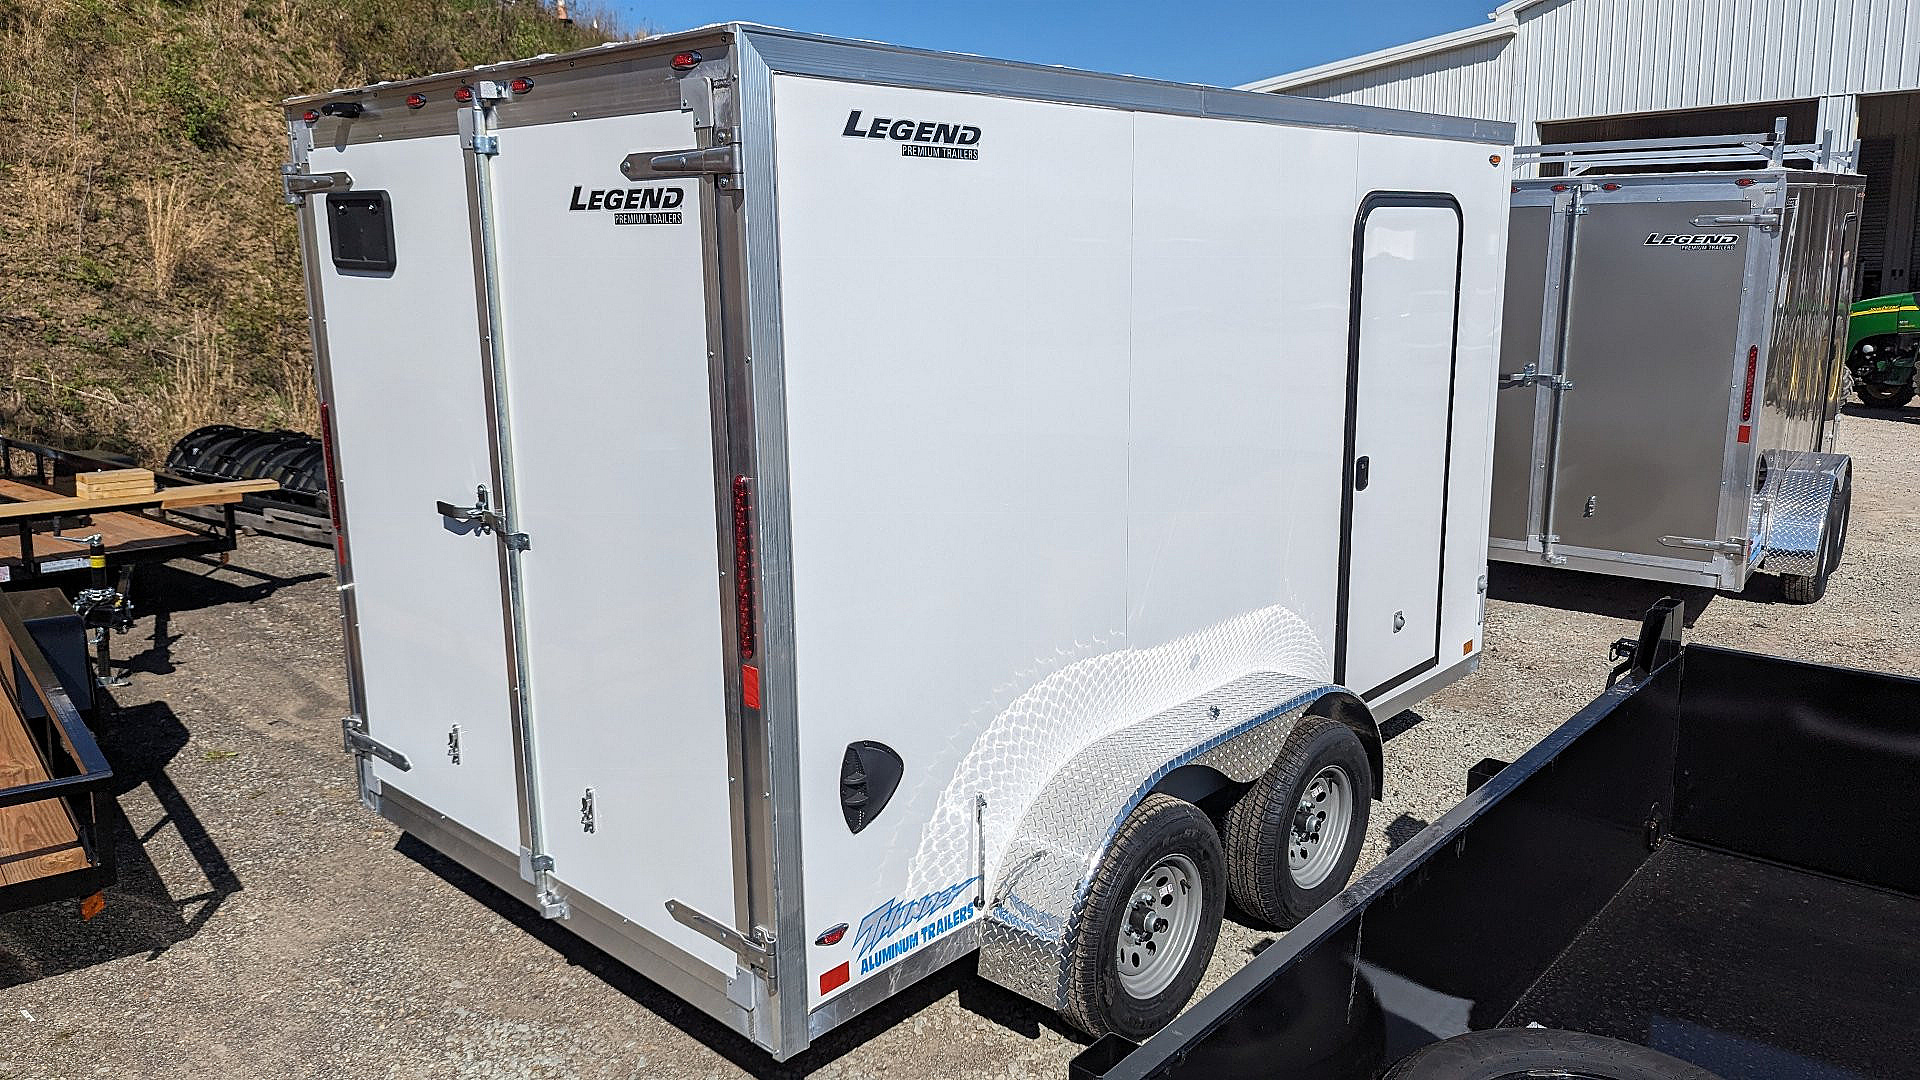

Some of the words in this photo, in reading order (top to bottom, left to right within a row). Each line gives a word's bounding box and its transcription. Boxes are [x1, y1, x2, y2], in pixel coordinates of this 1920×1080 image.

[842, 110, 982, 146] LEGEND
[902, 144, 940, 157] PREMIUM
[942, 147, 978, 160] TRAILERS
[569, 186, 684, 211] LEGEND
[615, 213, 647, 224] PREMIUM
[649, 212, 682, 224] TRAILERS
[1644, 233, 1740, 246] LEGEND
[860, 931, 919, 976] ALUMINUM
[920, 901, 974, 943] TRAILERS
